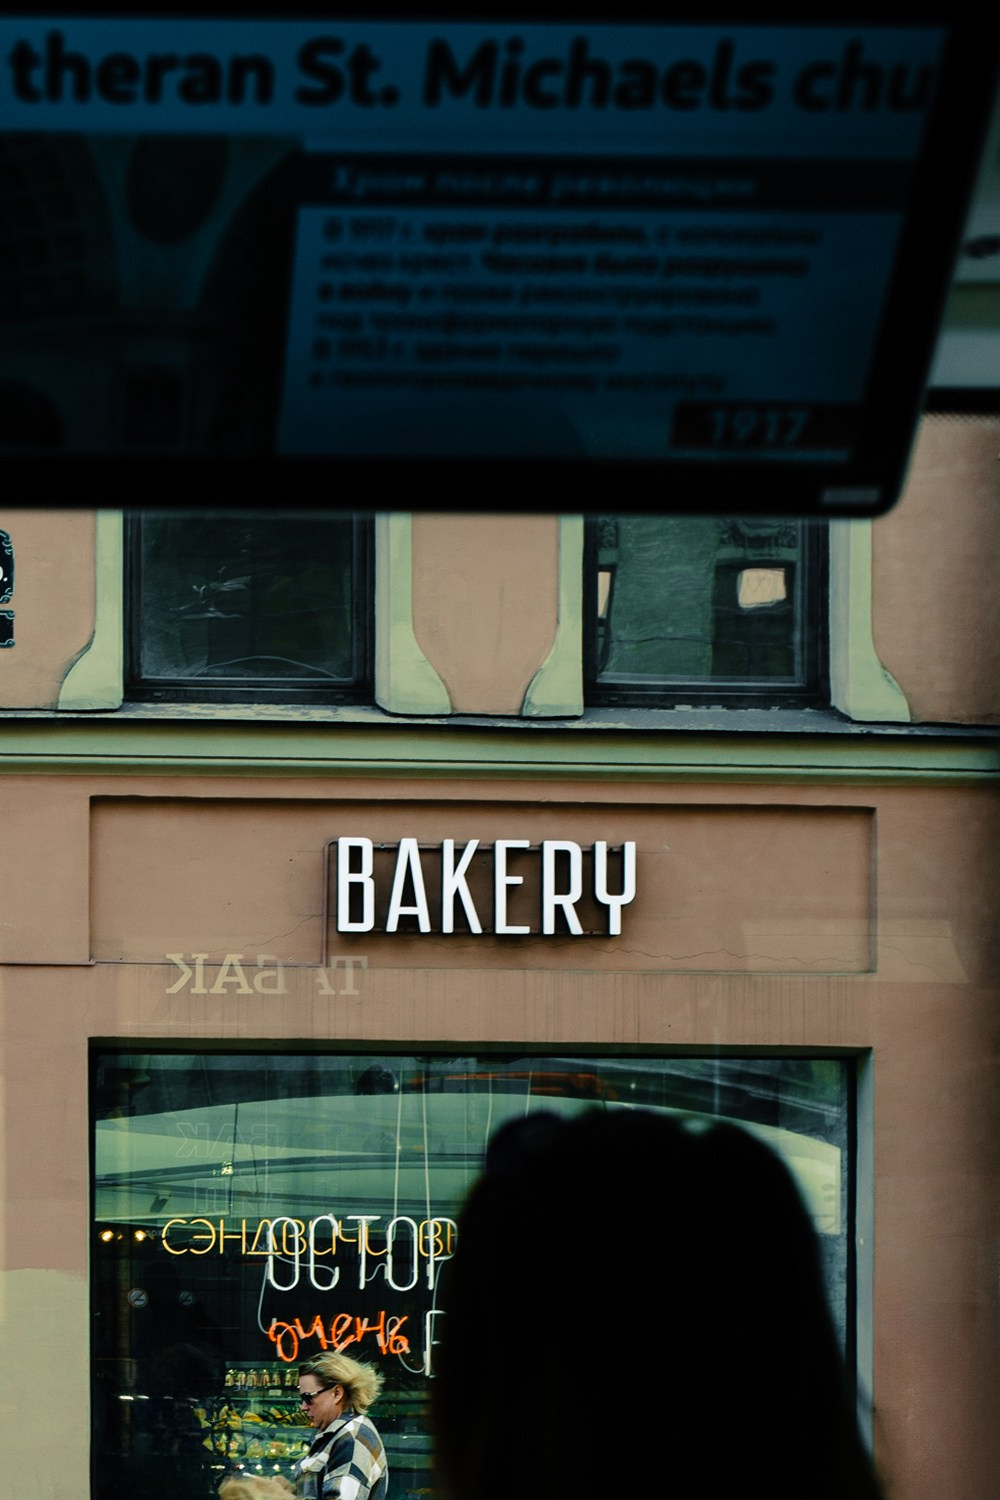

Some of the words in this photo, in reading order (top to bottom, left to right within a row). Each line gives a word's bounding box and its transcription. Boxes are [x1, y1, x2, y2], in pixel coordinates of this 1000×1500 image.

[10, 31, 275, 104] theran
[297, 38, 397, 107] St.
[425, 37, 773, 111] Michaels
[711, 410, 811, 442] 1917
[336, 837, 637, 936] BAKERY
